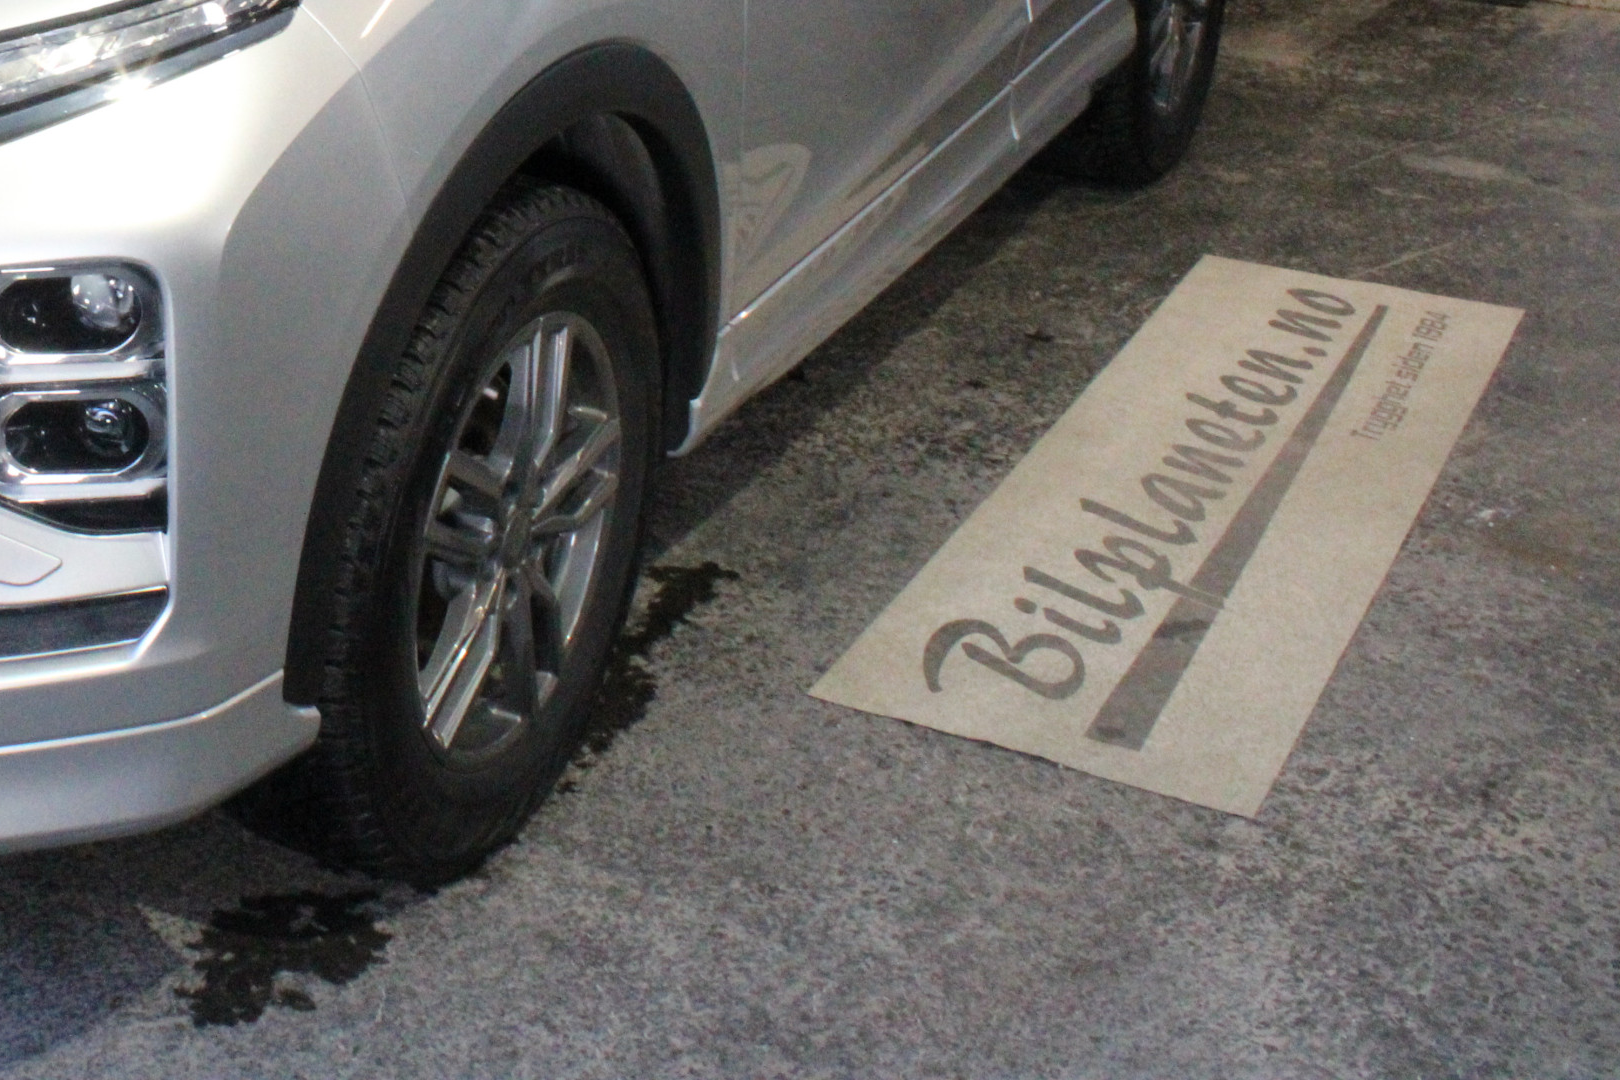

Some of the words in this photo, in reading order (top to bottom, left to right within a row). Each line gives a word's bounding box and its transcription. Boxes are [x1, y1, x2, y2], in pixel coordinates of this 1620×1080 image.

[1411, 310, 1452, 342] 1984
[1390, 342, 1435, 383] siden
[922, 286, 1357, 700] Bilplaneten.no
